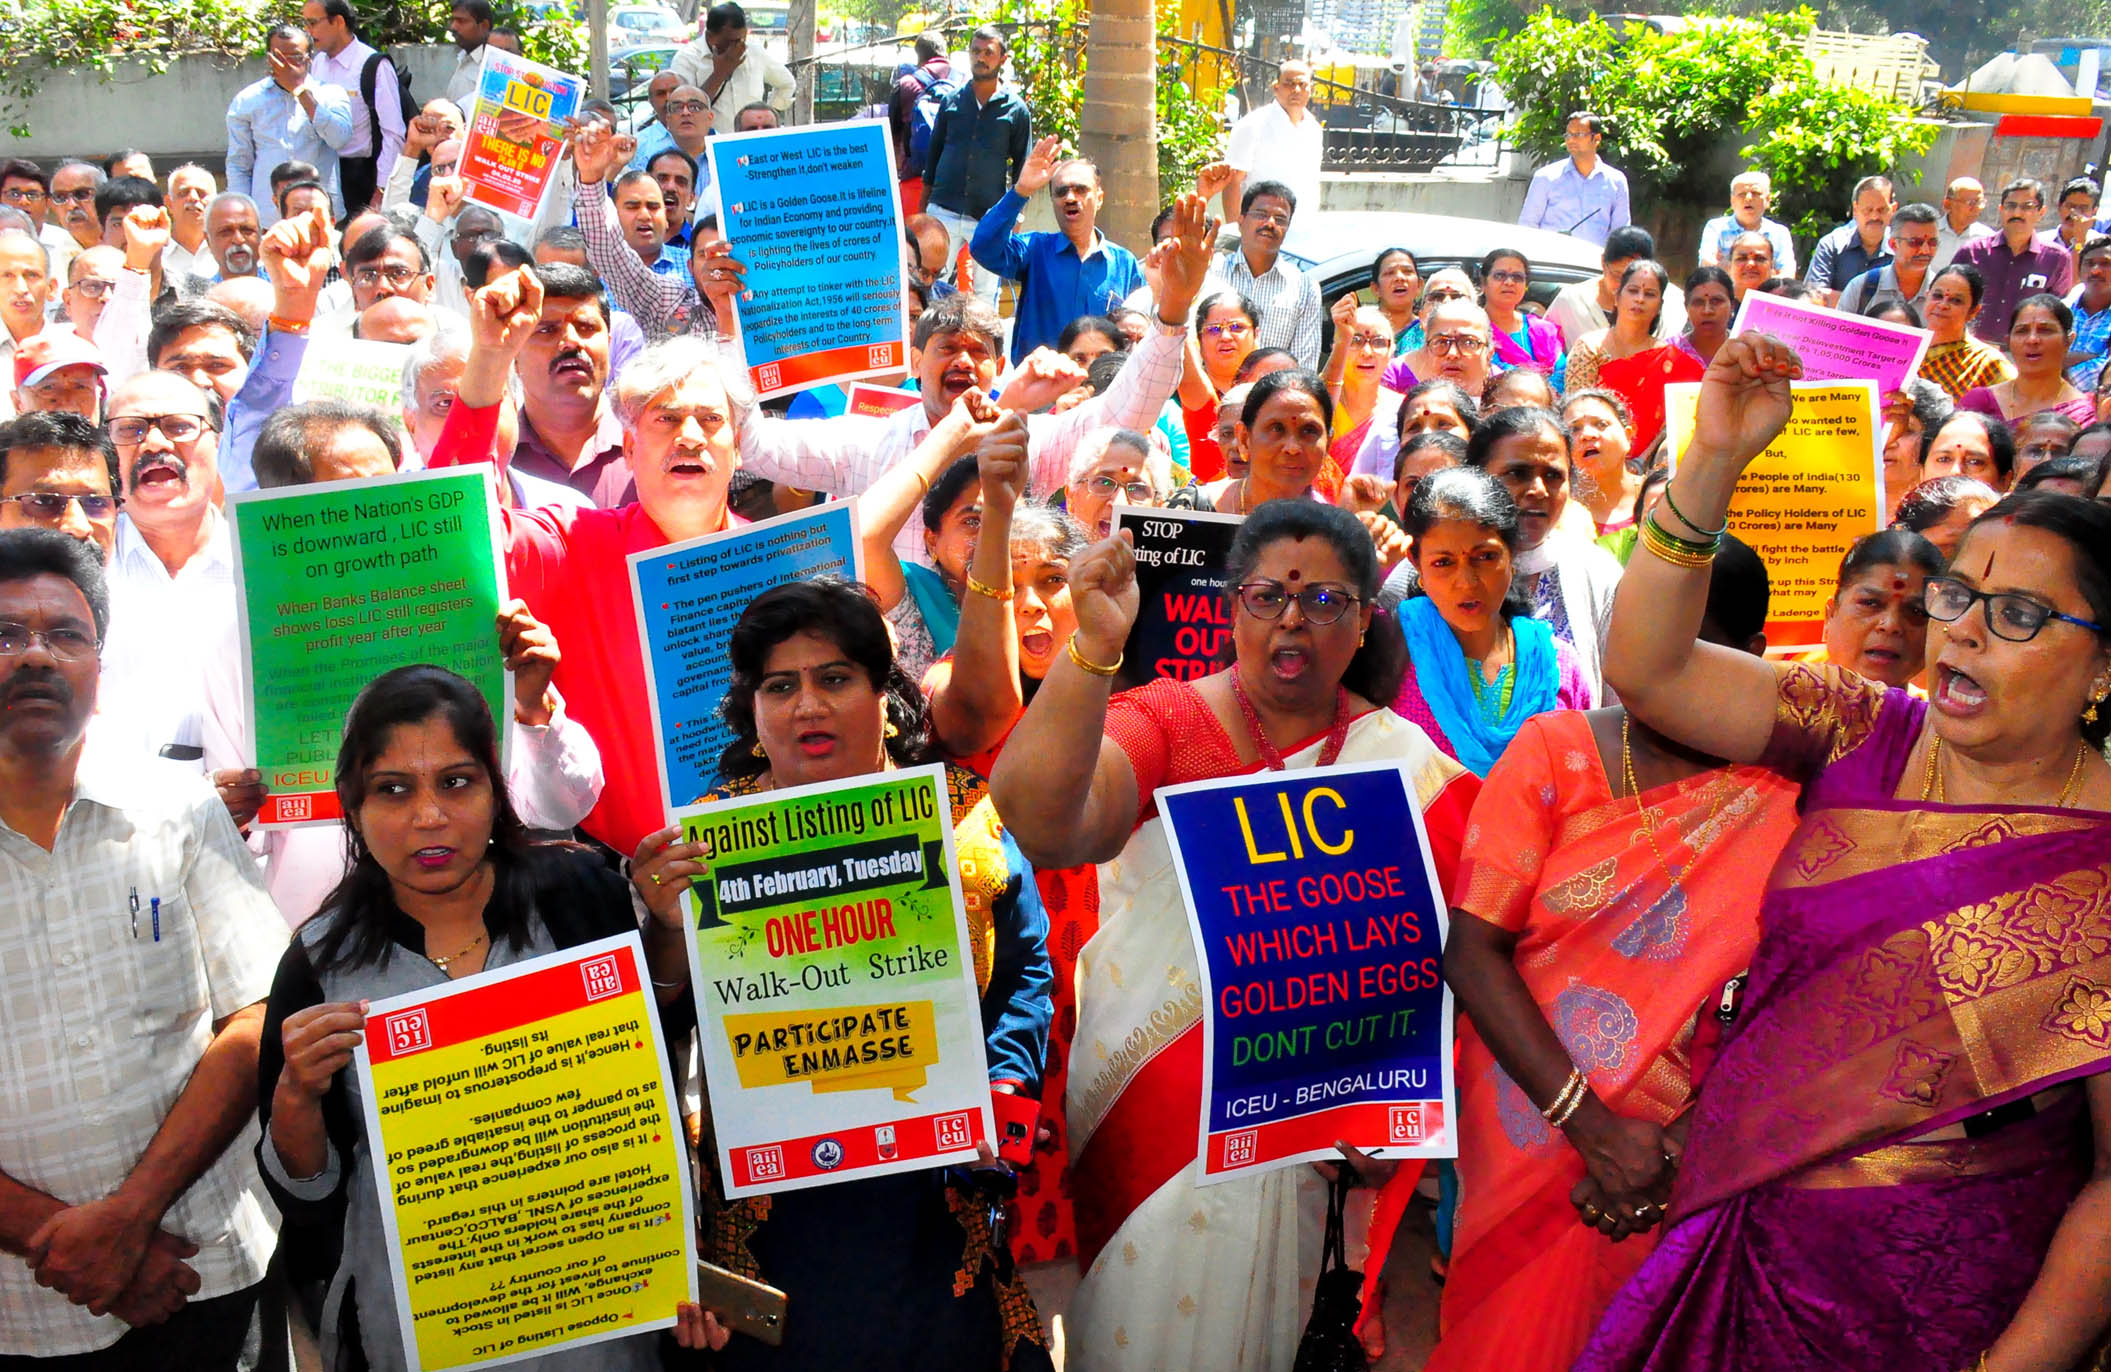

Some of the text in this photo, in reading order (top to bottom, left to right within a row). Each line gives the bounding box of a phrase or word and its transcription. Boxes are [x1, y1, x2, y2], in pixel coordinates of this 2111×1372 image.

[508, 84, 546, 114] LIC
[482, 134, 545, 168] THERE IS NO
[497, 154, 516, 167] PLAN
[747, 143, 868, 164] East or West LIC is the best
[474, 155, 539, 183] WALK OUT STRIKE
[745, 167, 796, 180] -Strengthen
[830, 160, 863, 170] weaken
[741, 200, 757, 212] LIC
[758, 199, 768, 210] is
[769, 200, 775, 209] a
[777, 196, 807, 207] Golden
[847, 190, 855, 200] is
[856, 185, 887, 200] lifeline
[858, 402, 897, 415] Respect
[1829, 391, 1861, 402] Many
[1793, 425, 1860, 437] LIC are few,
[1801, 415, 1841, 424] wanted
[1764, 448, 1786, 458] But,
[1750, 472, 1788, 482] People
[1792, 472, 1803, 480] of
[262, 490, 463, 531] When the Nation's GDP
[1746, 507, 1865, 519] Policy Holders of LIC
[271, 515, 461, 558] is downward LIC still
[679, 521, 827, 569] Listing of LIC is nothing but
[1142, 520, 1183, 540] STOP
[305, 544, 437, 577] on growth path
[666, 537, 830, 587] first step towards privatization
[1164, 547, 1206, 566] of LIC
[277, 578, 466, 616] When Banks Balance sheet
[672, 556, 845, 611] The pen pushers of International
[1191, 578, 1207, 587] one
[273, 597, 472, 636] shows loss LIC still registers
[1164, 593, 1230, 625] WAL
[1772, 607, 1820, 618] Ladenge
[305, 620, 445, 653] profit year after year
[273, 768, 329, 788] ICEU
[687, 785, 932, 861] Against Listing of LIC
[1234, 787, 1354, 864] LIC
[718, 844, 925, 904] 4th February, Tuesday
[1222, 866, 1405, 917] THE GOOSE
[765, 898, 896, 957] ONE HOUR
[1225, 912, 1422, 967] WHICH LAYS
[713, 944, 947, 1004] Walk-Out Strike
[1220, 957, 1439, 1019] GOLDEN EGGS
[479, 1029, 549, 1058] its listing.
[734, 1007, 908, 1057] PARTICIPATE
[1232, 1009, 1418, 1066] DONT CUT IT.
[382, 1020, 638, 1101] that real value of LIC will unfold after
[783, 1035, 912, 1077] ENMASSE
[1226, 1068, 1428, 1118] ICEU BENGALURU
[471, 1313, 618, 1357] Oppose Listing of LIC
